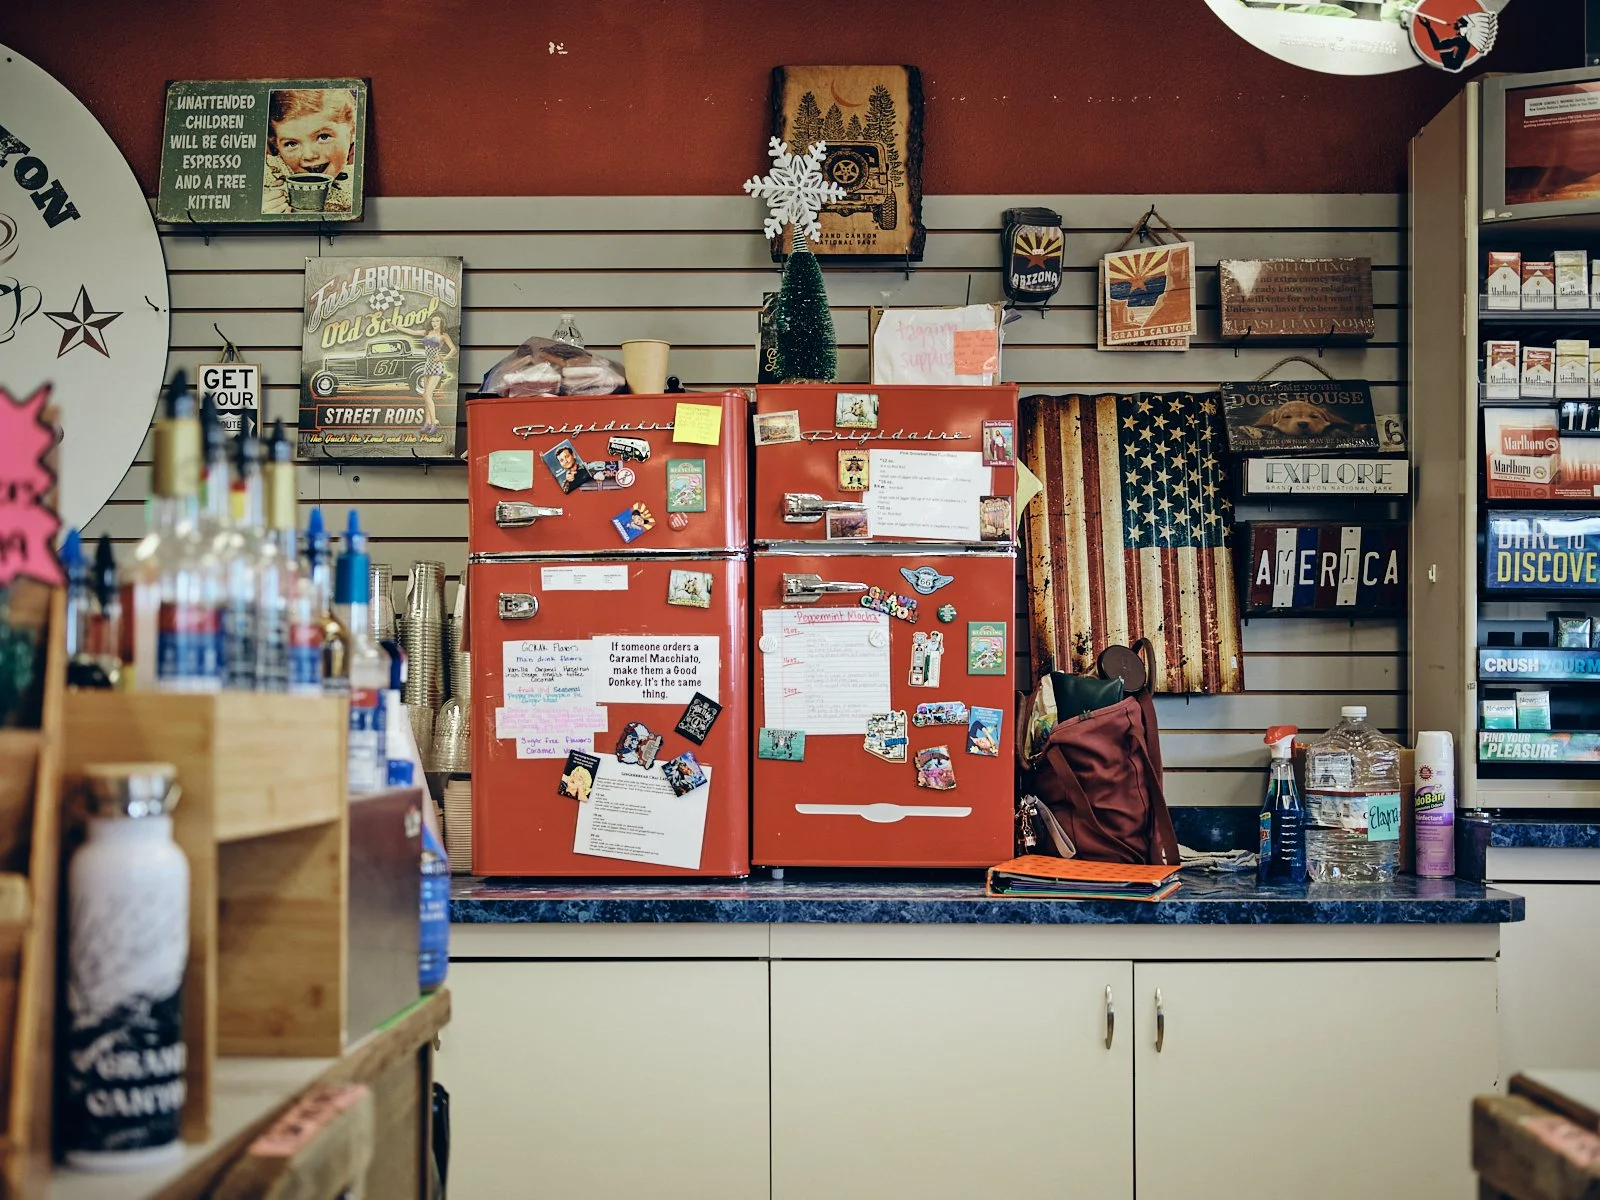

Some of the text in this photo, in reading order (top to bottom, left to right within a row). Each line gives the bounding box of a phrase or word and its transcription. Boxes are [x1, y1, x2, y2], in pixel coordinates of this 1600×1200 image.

[177, 95, 256, 110] UNATTENDED
[185, 115, 245, 129] CHILDREN
[170, 134, 257, 149] WILL BE GIVEN
[183, 155, 242, 169] ESPRESSO
[175, 174, 247, 189] AND A FREE
[188, 194, 231, 210] KITTEN
[817, 233, 842, 241] RAND
[1012, 271, 1060, 289] ARIZONA
[308, 266, 458, 333] Fast BROTHERS
[1227, 304, 1256, 313] Unless
[321, 297, 440, 349] Old School
[1114, 324, 1191, 340] GRAND CANYON
[373, 360, 400, 376] 61
[204, 369, 254, 390] GET
[1231, 392, 1366, 407] DOG'S HOUSE
[324, 407, 426, 424] STREET RODS
[217, 420, 242, 430] OUTE
[512, 420, 674, 443] Frigidaire
[310, 432, 323, 443] The
[349, 432, 362, 443] The
[387, 433, 402, 443] and
[404, 432, 418, 443] The
[419, 432, 444, 443] Proud
[799, 428, 973, 446] Frigidaire
[1384, 421, 1405, 446] 6
[1504, 434, 1545, 451] Marlboro
[1266, 463, 1393, 485] EXPLORE
[1493, 459, 1531, 475] Marlboro
[1255, 549, 1399, 588] AMERICA
[611, 641, 699, 652] If someone orders a
[609, 653, 702, 665] Caramel Macchiato,
[1484, 658, 1540, 673] CRUSH
[1542, 658, 1586, 673] YOUR
[613, 665, 698, 676] make them a Good
[608, 677, 703, 688] Donkey. It's the same
[642, 688, 668, 700] thing.
[545, 737, 560, 745] free
[1483, 732, 1531, 744] FIND YOUR
[1486, 743, 1559, 759] PLEASURE
[1415, 793, 1445, 806] doBan
